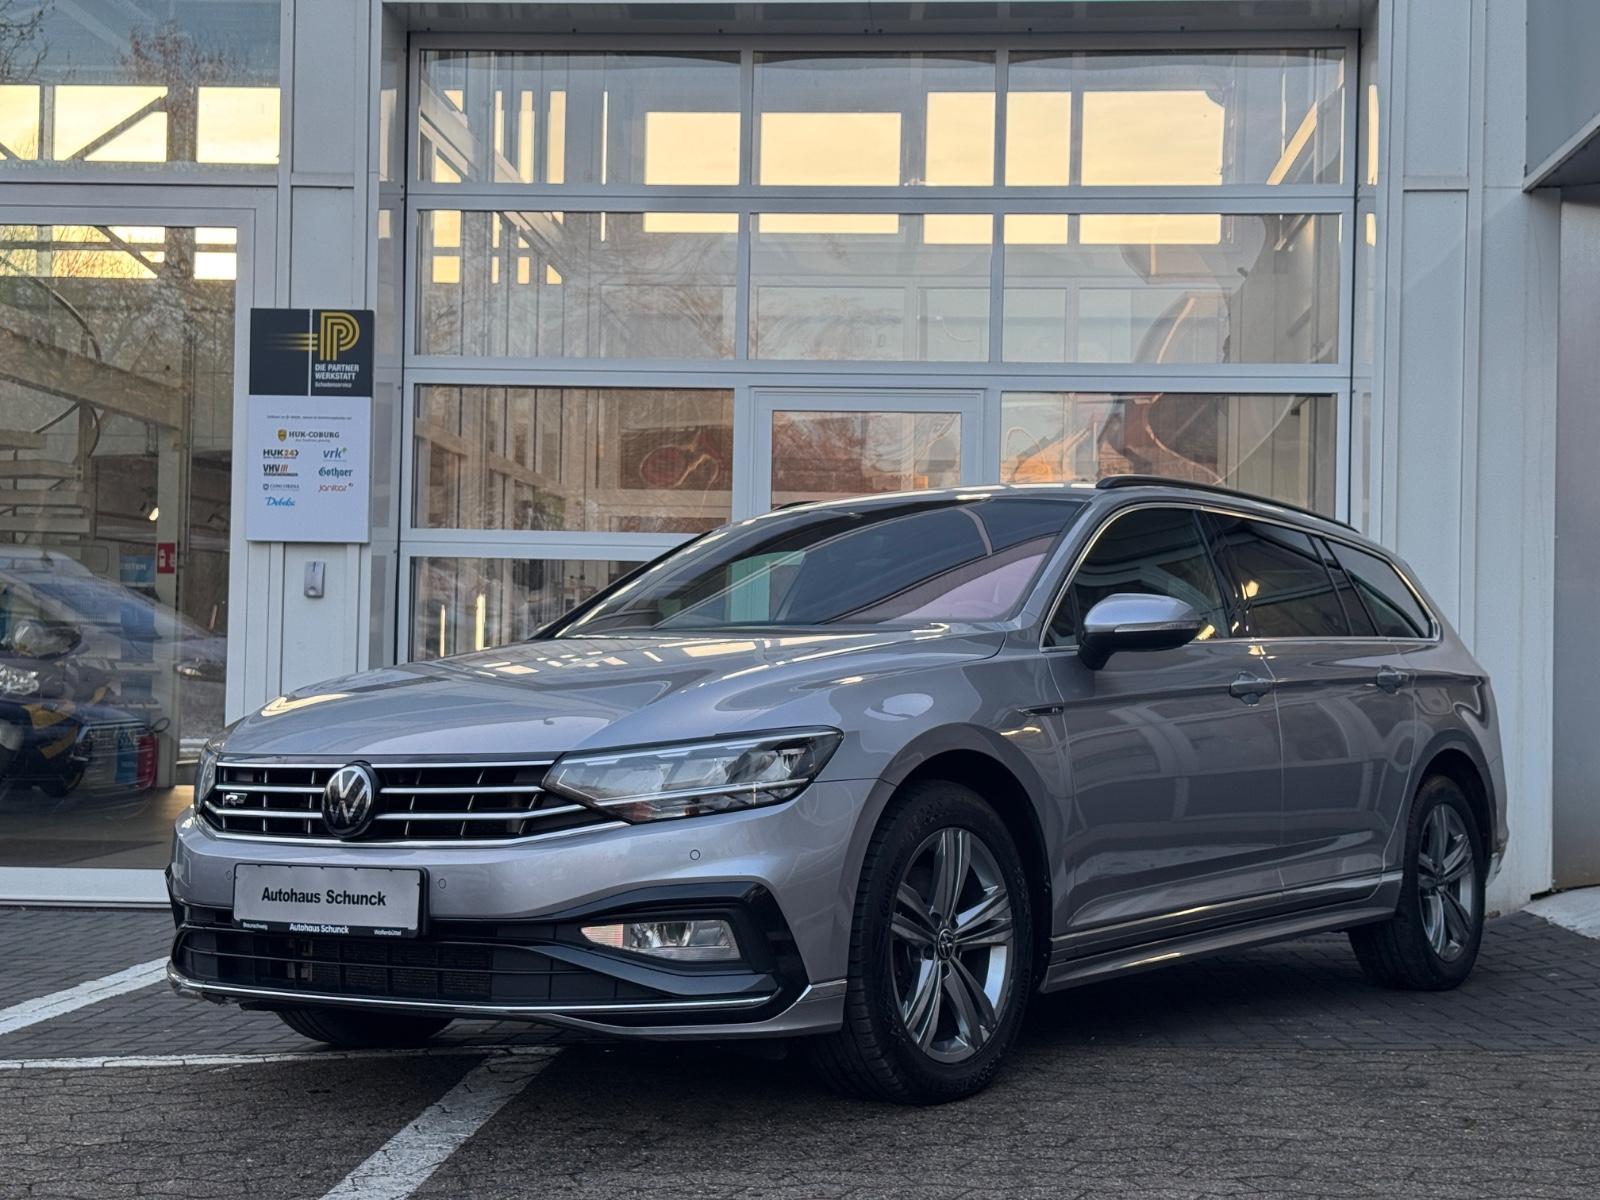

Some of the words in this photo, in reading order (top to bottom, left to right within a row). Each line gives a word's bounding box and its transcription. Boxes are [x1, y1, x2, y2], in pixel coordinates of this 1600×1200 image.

[314, 363, 327, 372] DIE
[327, 363, 360, 373] PARTNER
[314, 372, 357, 381] WERKSTATT
[288, 431, 340, 439] HUK-COBURG
[323, 447, 342, 459] vrk
[261, 886, 321, 904] Autohaus
[325, 888, 387, 906] Schunck
[289, 923, 320, 933] Autohaus
[320, 925, 350, 934] Schunck
